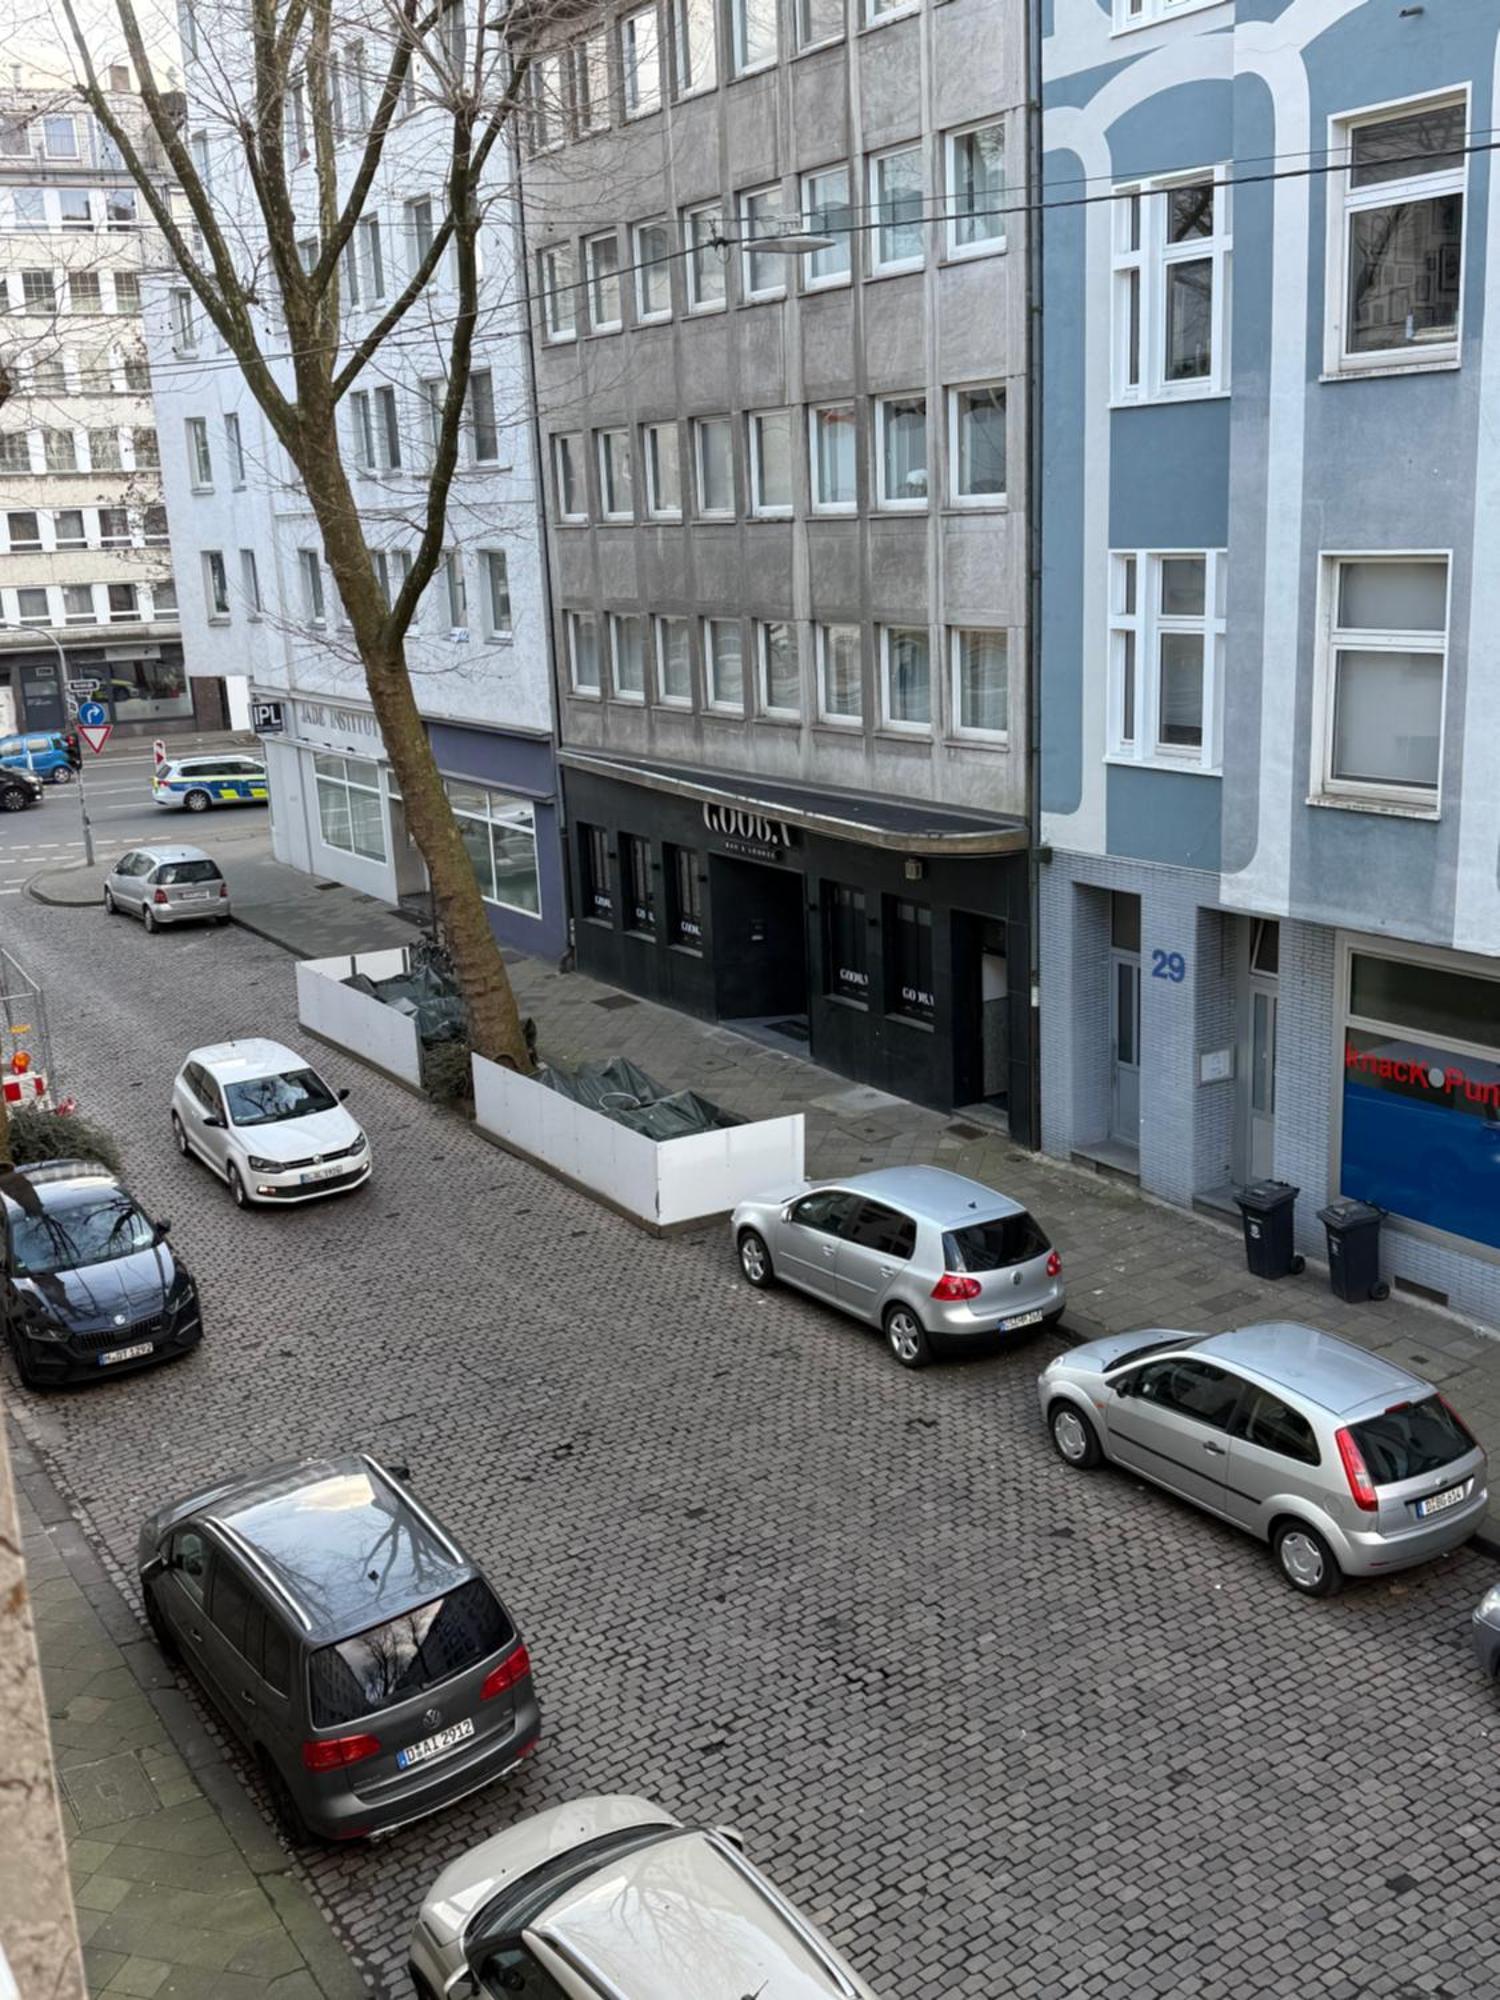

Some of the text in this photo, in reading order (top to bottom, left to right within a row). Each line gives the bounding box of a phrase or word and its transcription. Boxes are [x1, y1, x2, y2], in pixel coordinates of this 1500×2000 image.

[253, 705, 281, 725] IPL
[301, 702, 327, 727] JADE
[1151, 948, 1186, 983] 29
[406, 1720, 473, 1762] D AI 2912
